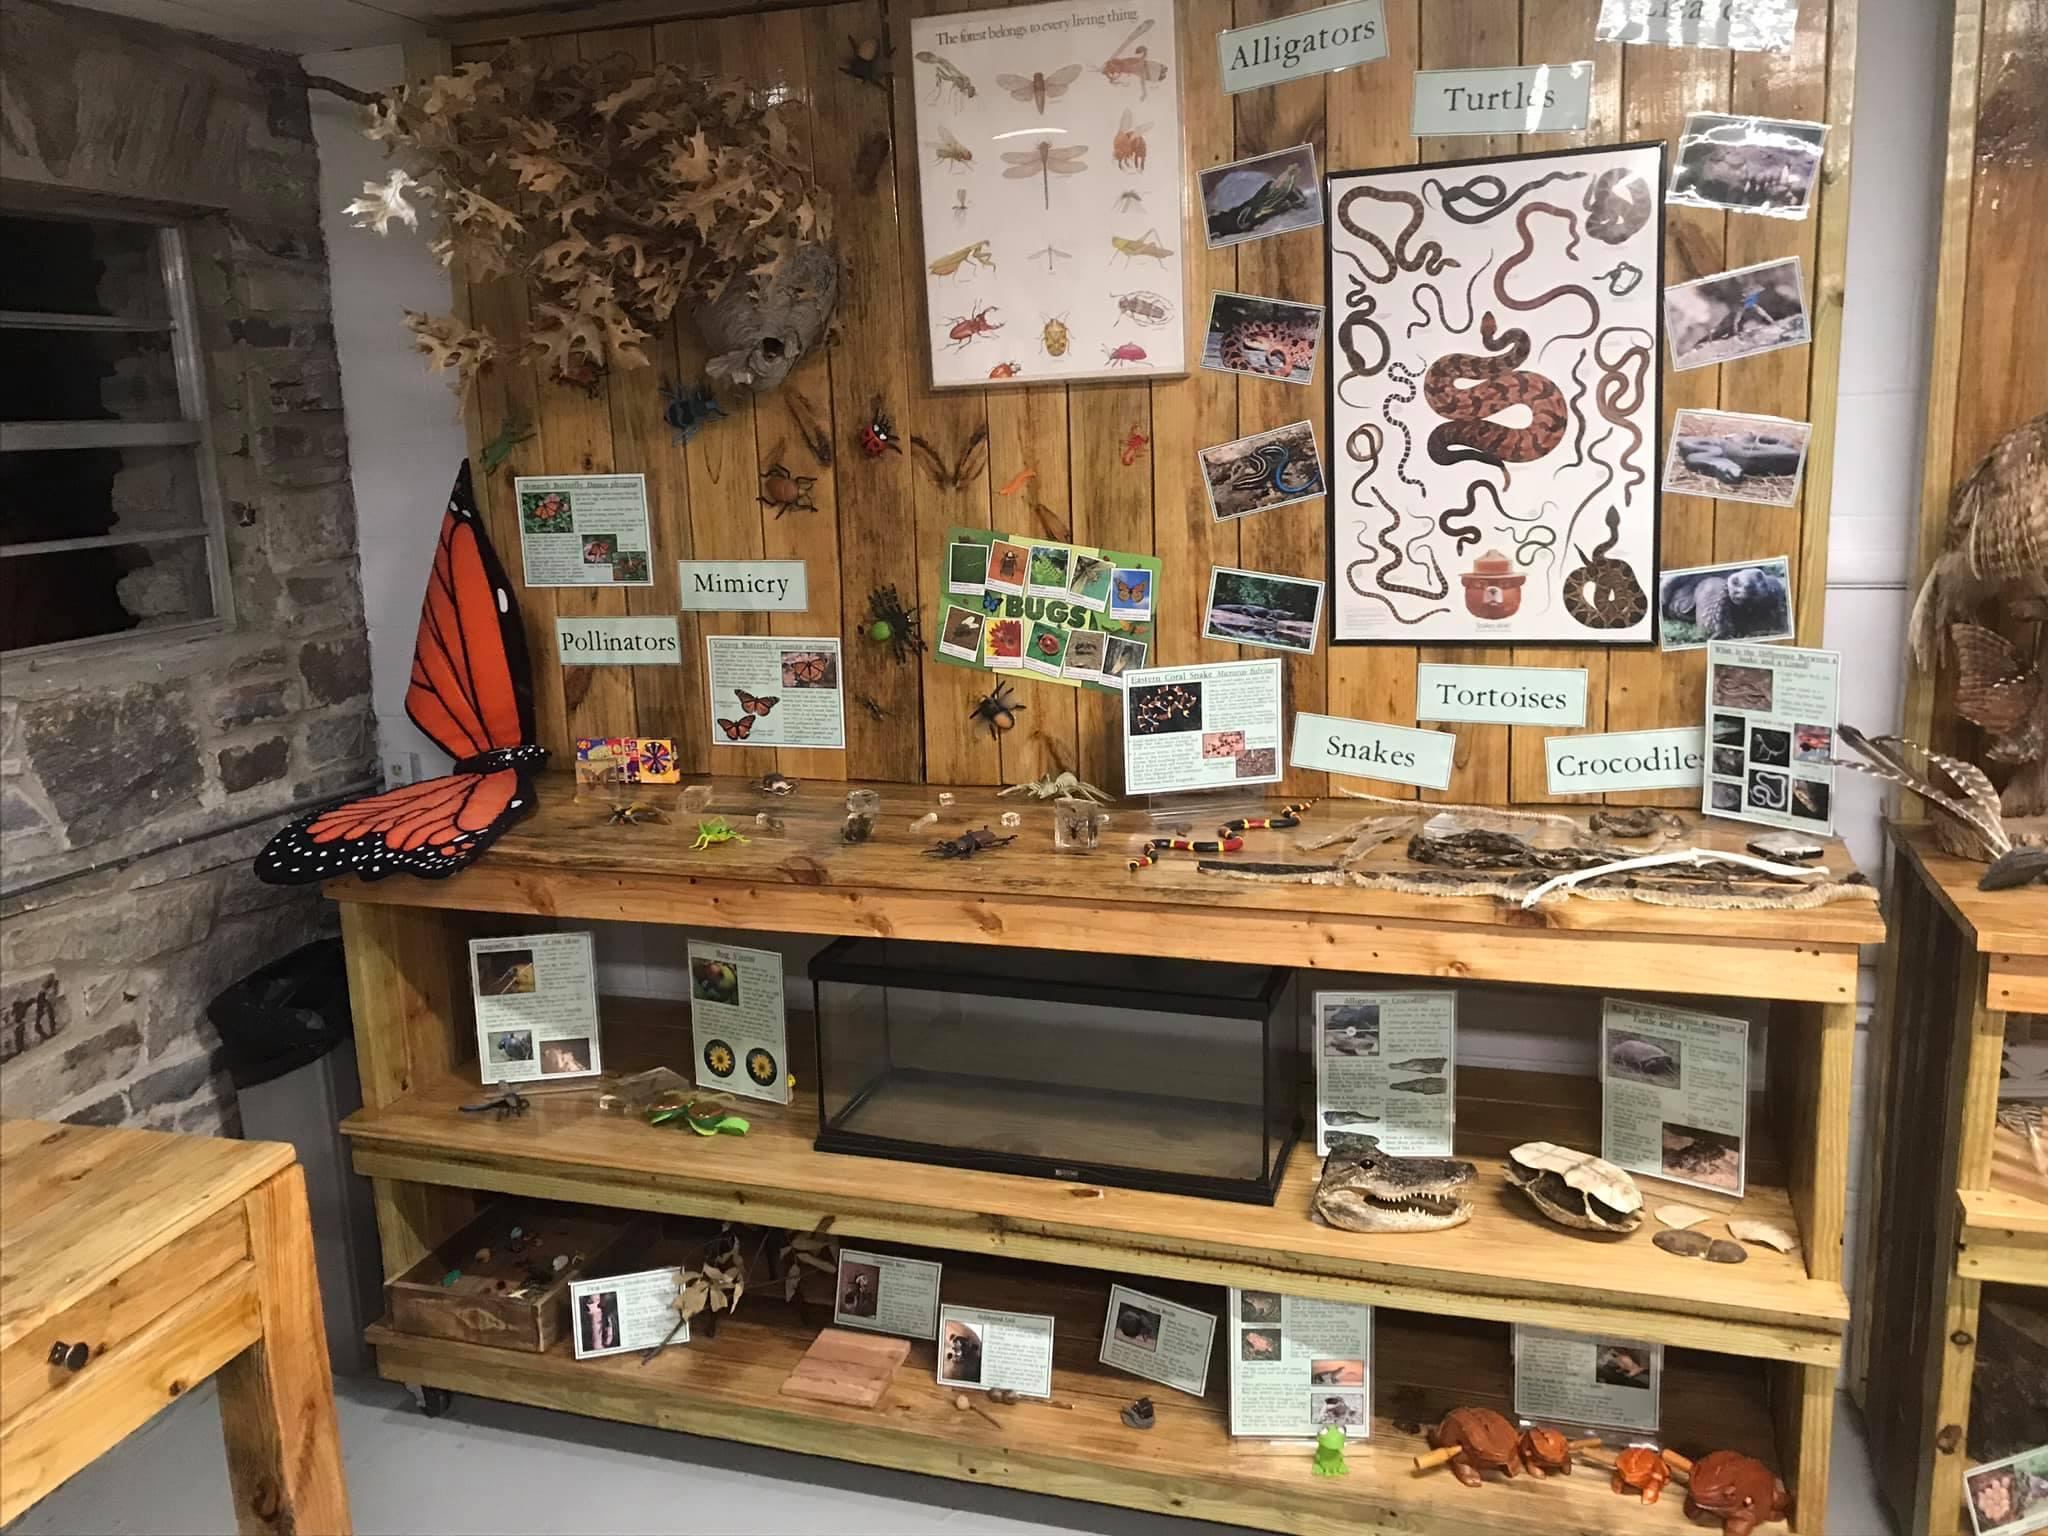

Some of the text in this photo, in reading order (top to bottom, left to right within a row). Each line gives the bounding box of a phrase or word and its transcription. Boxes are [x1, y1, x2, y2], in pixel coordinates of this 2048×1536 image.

[935, 8, 1138, 46] The forest belongs to every living thing
[1229, 19, 1377, 72] Alligators
[694, 572, 789, 601] Mimicry
[1005, 595, 1088, 629] BUGS
[561, 630, 676, 651] Pollinators
[1131, 675, 1161, 685] Eastern
[1165, 672, 1186, 682] Coral
[1190, 671, 1213, 680] Snake
[1436, 683, 1568, 710] Tortoises
[1326, 735, 1416, 768] Snakes
